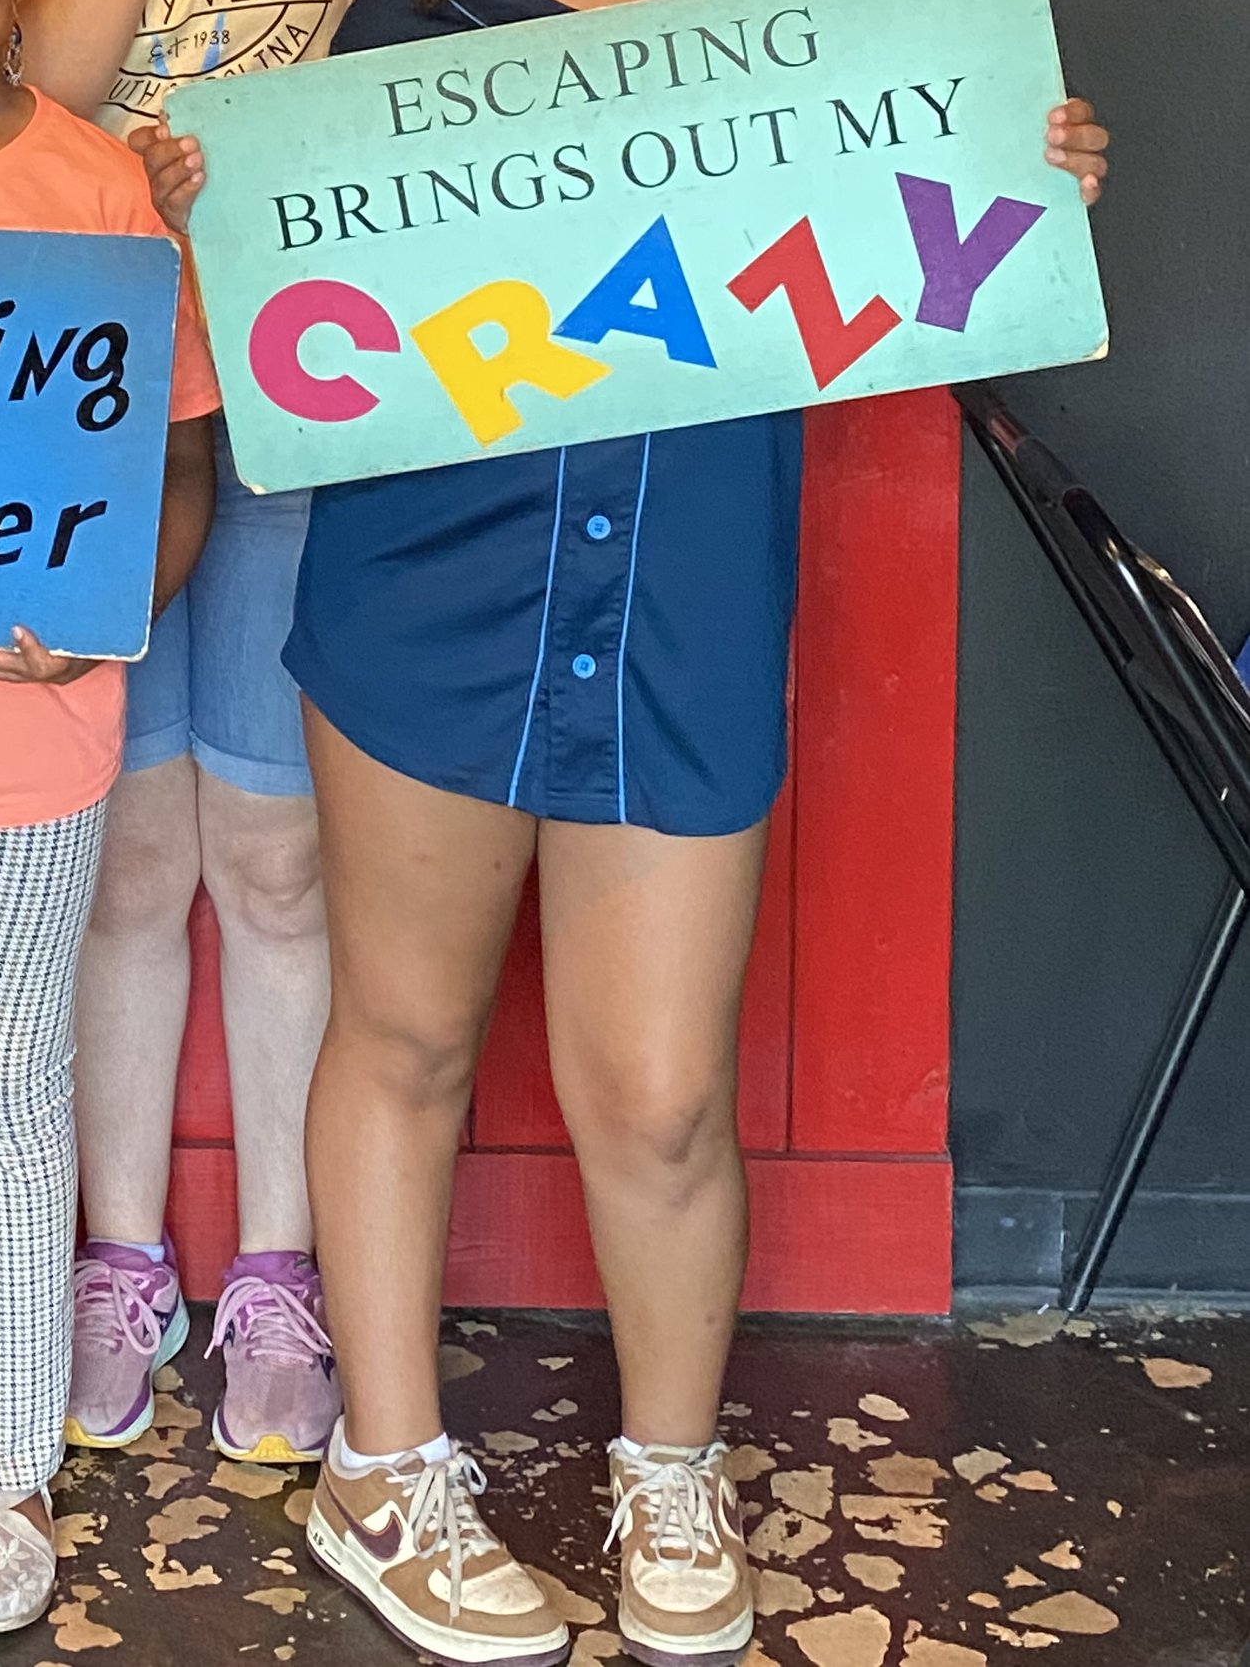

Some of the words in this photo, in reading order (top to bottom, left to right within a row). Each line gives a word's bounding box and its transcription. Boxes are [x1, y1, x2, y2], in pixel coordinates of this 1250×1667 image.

[108, 77, 161, 107] UTH
[194, 29, 230, 49] 1938
[380, 6, 823, 138] ESCAPING
[272, 144, 596, 251] BRINGS
[621, 107, 800, 189] OUT
[830, 76, 967, 156] MY
[248, 171, 1049, 448] CRAZY
